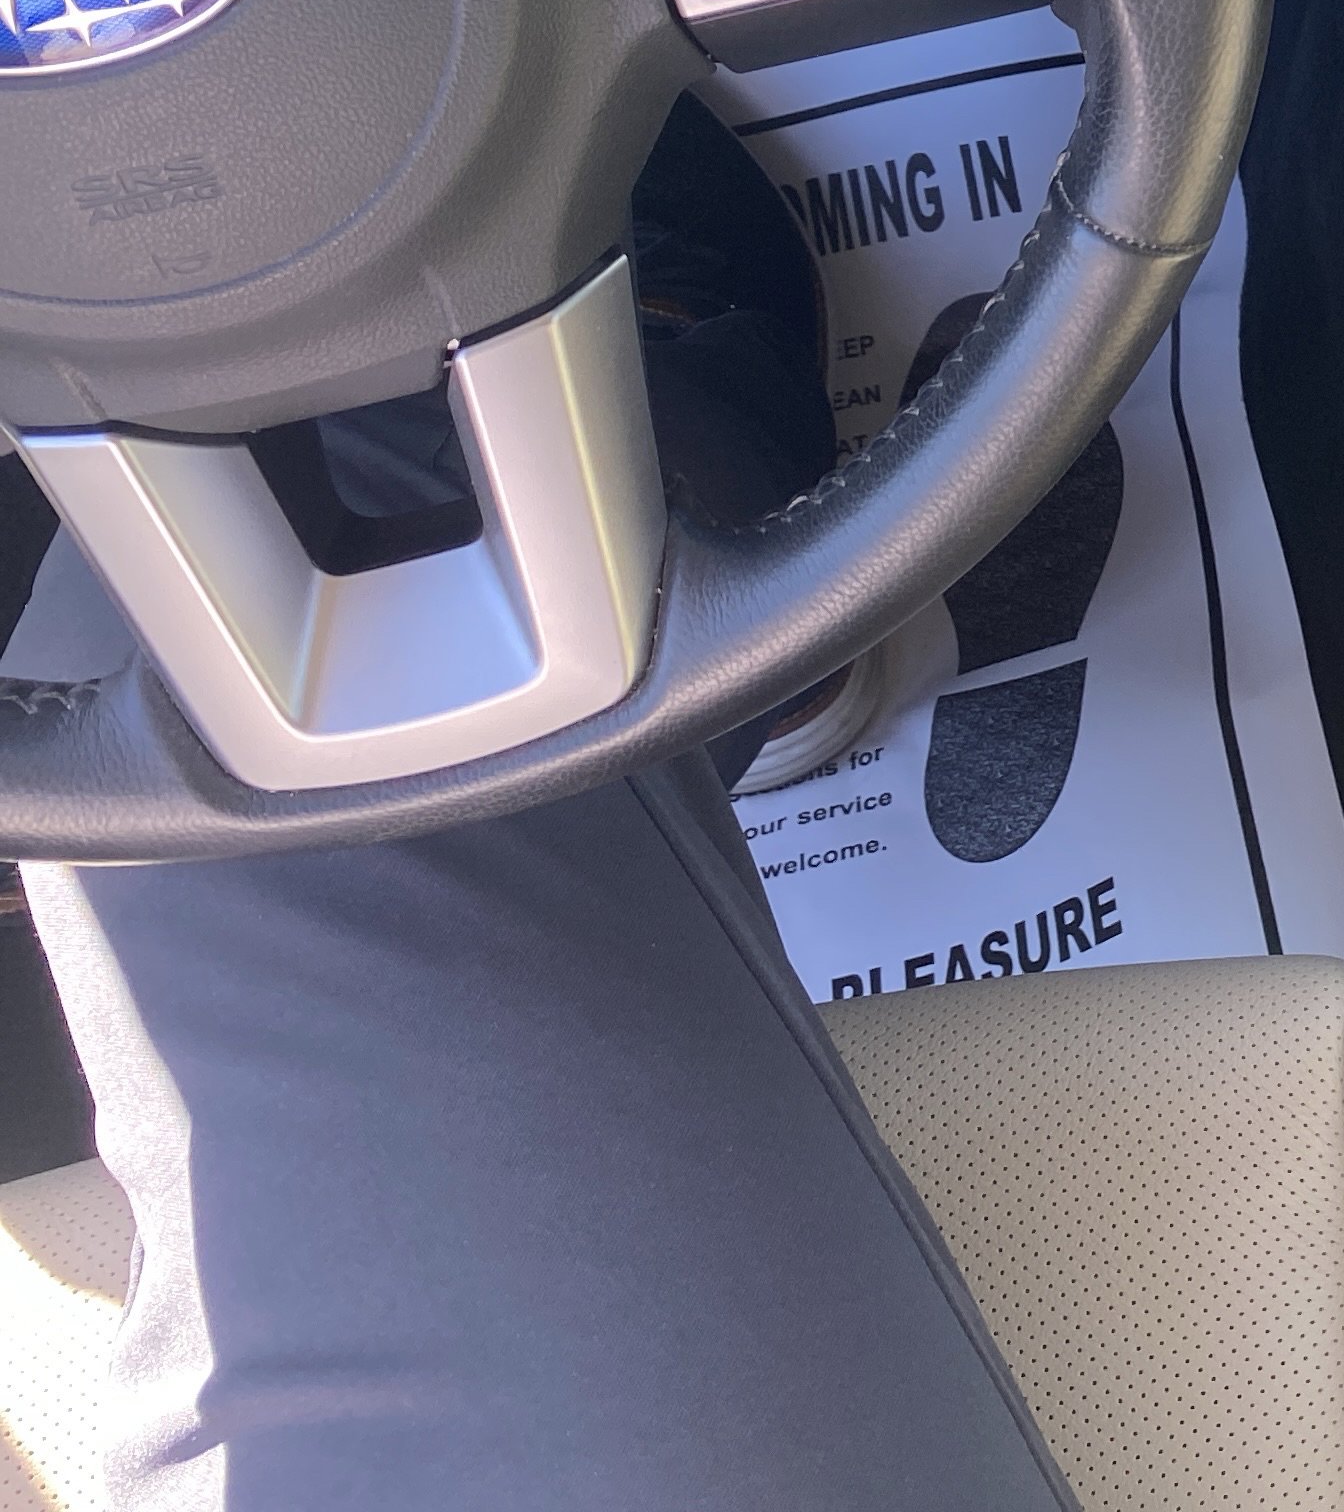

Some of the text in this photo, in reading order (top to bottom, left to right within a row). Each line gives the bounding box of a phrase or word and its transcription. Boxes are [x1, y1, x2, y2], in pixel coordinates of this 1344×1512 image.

[959, 135, 1022, 221] IN
[849, 747, 884, 770] for
[798, 791, 893, 825] service
[761, 839, 887, 879] welcome.
